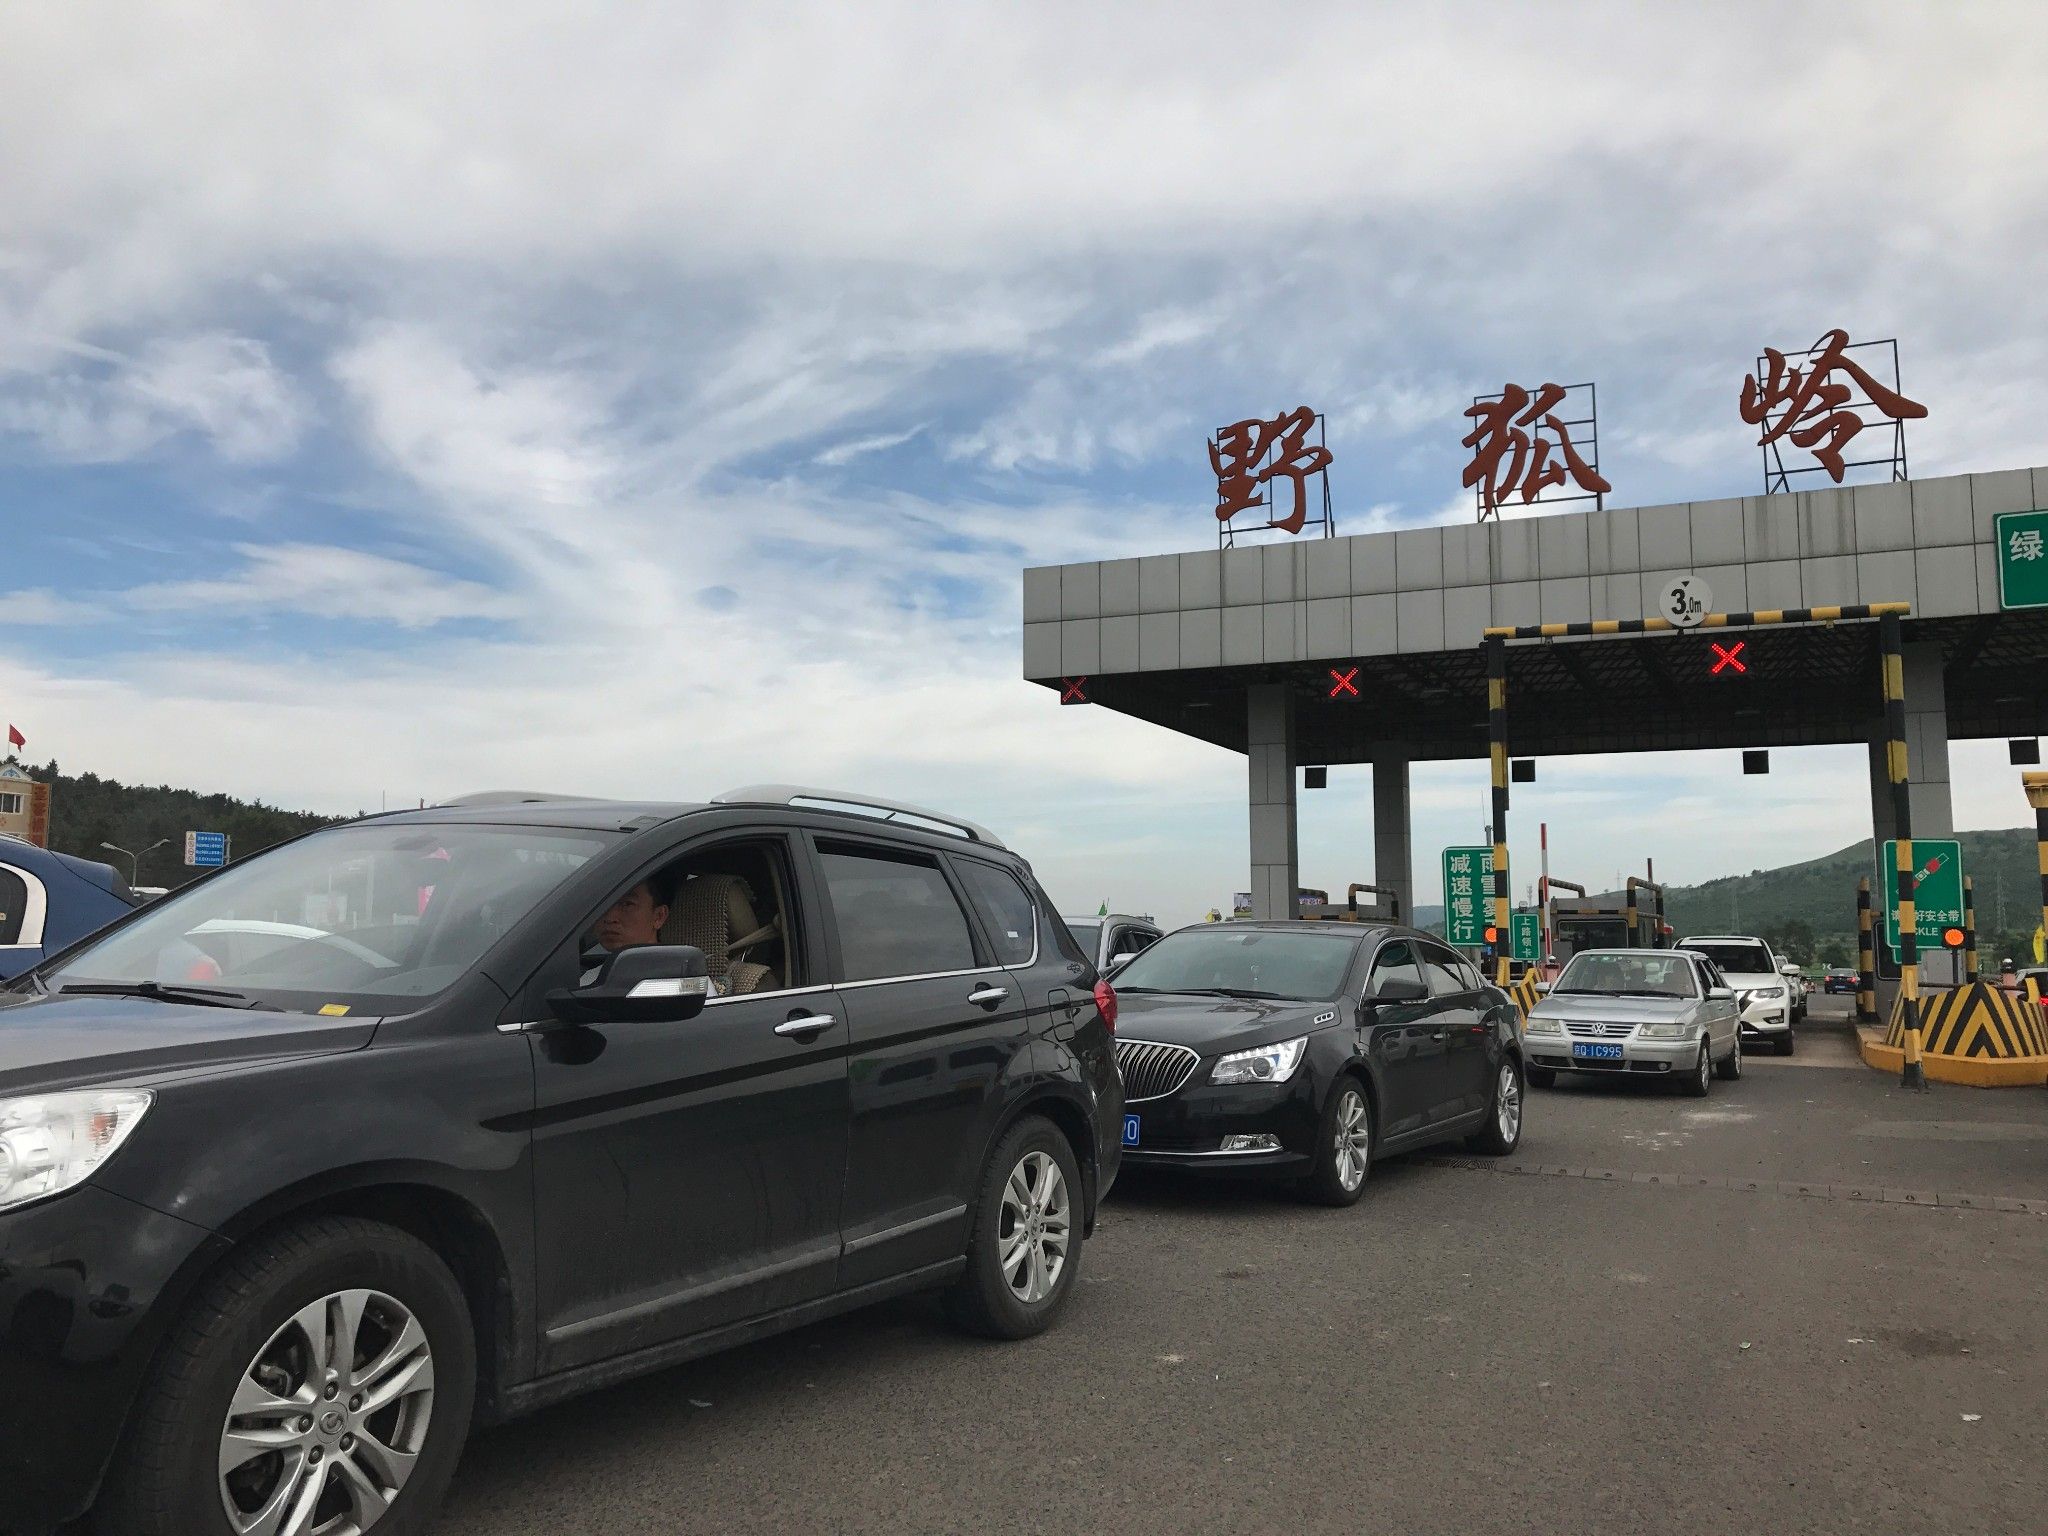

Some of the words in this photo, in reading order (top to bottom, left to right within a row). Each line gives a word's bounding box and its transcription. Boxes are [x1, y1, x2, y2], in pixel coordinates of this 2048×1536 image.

[2008, 529, 2045, 562] 绿
[1450, 853, 1475, 940] 减速慢行
[1891, 909, 1960, 922] 请好安全带
